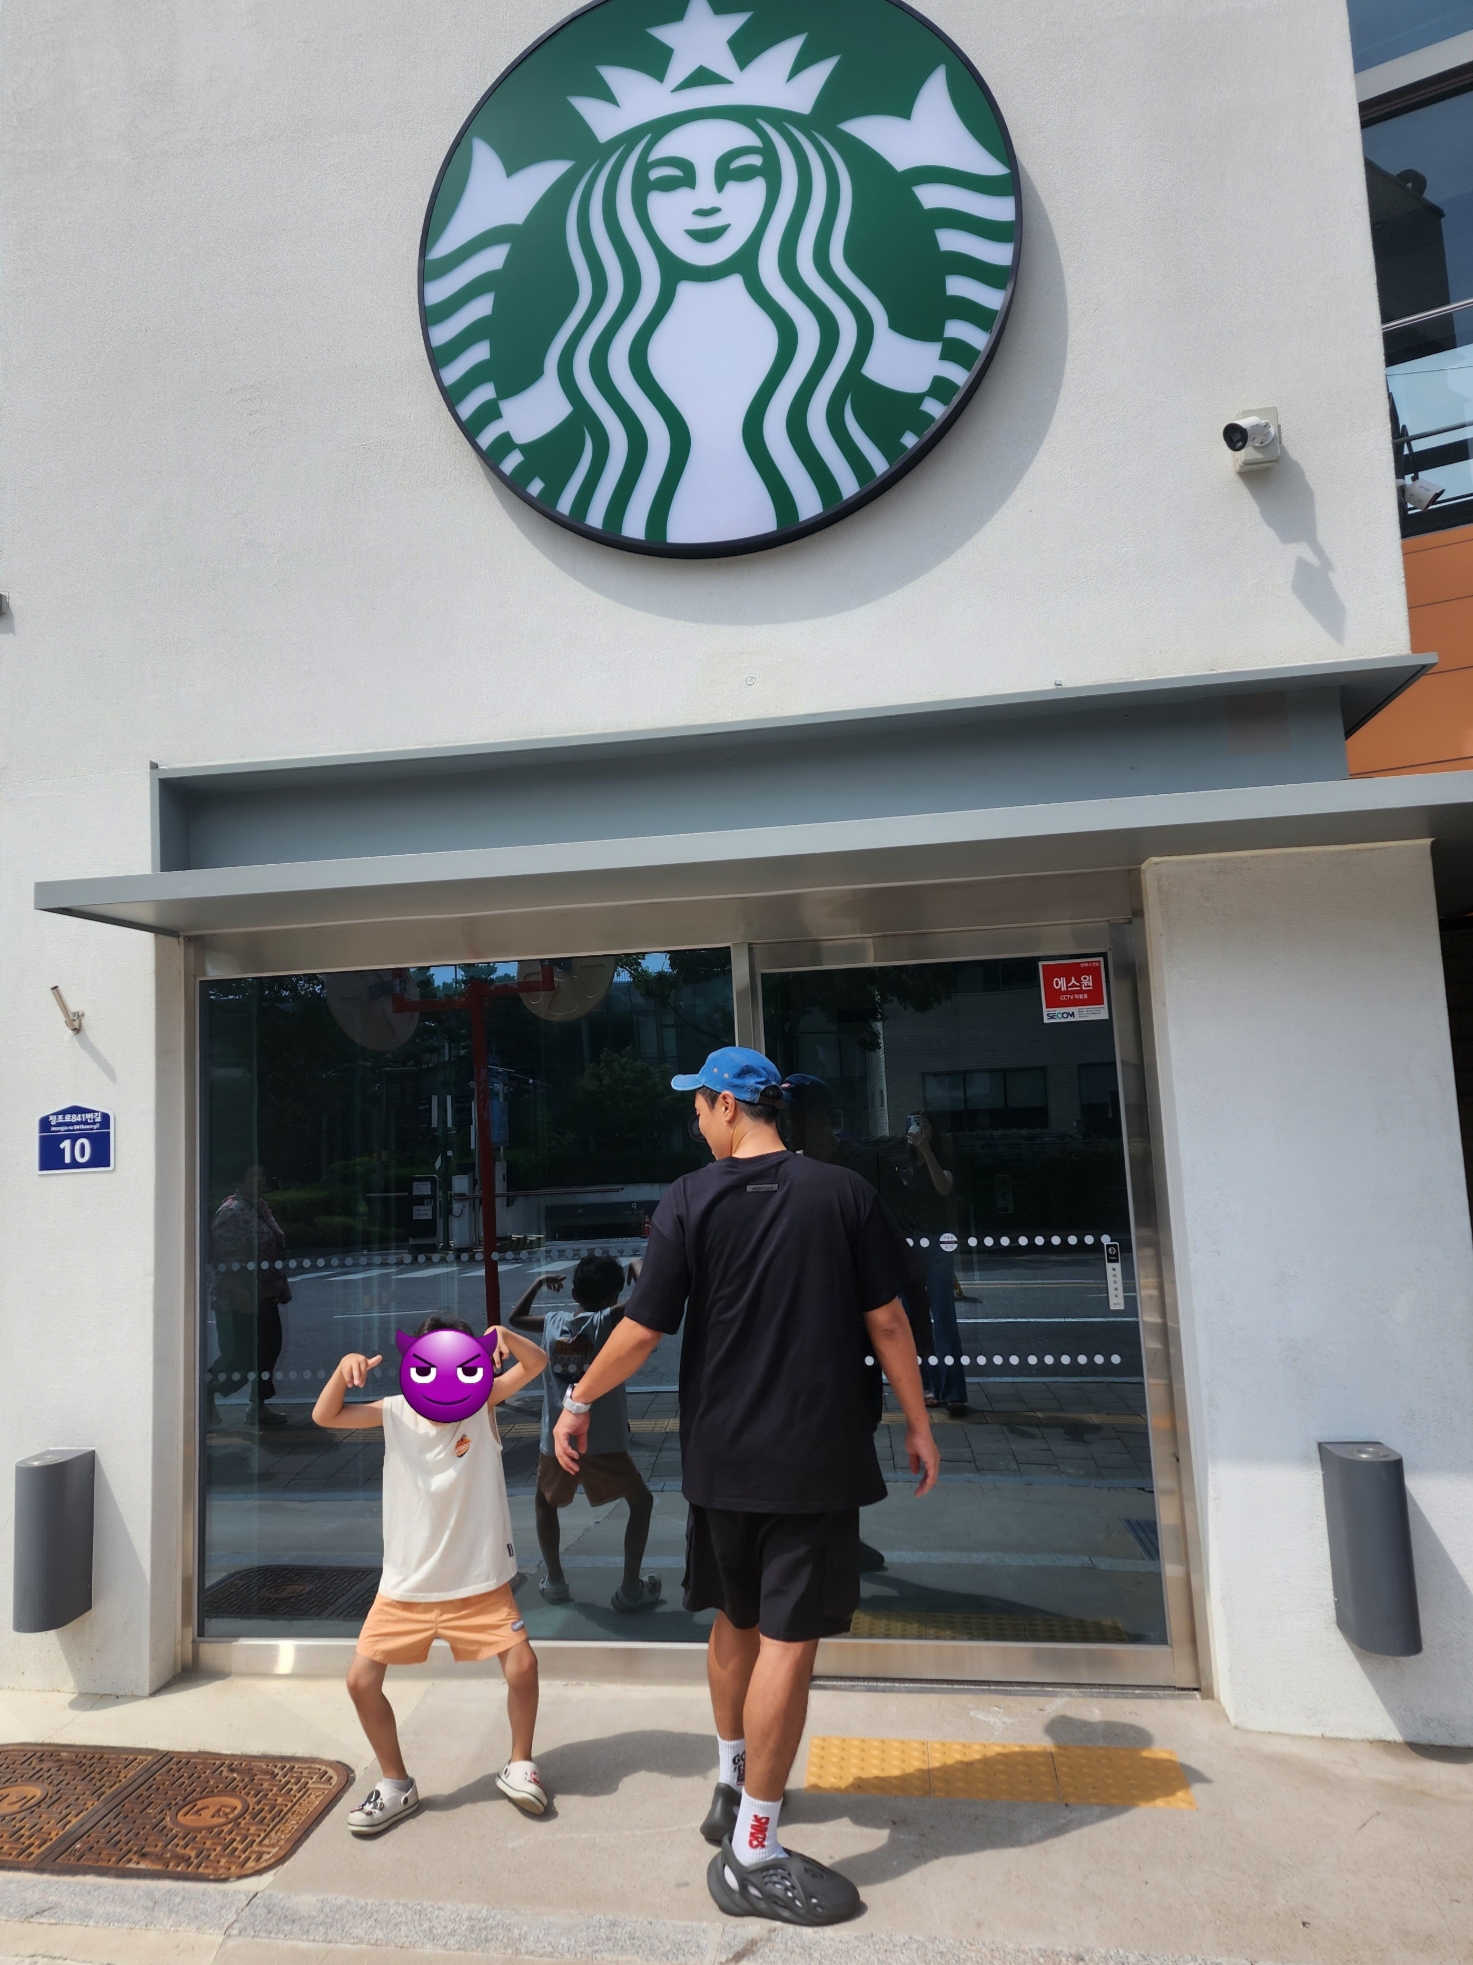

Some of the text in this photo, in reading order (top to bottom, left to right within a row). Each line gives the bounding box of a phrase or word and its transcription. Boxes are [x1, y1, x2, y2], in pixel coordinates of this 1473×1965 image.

[1053, 975, 1093, 991] 에스원
[1046, 1011, 1075, 1020] SECOM
[48, 1112, 101, 1125] 정조로841번길
[59, 1138, 91, 1163] 10
